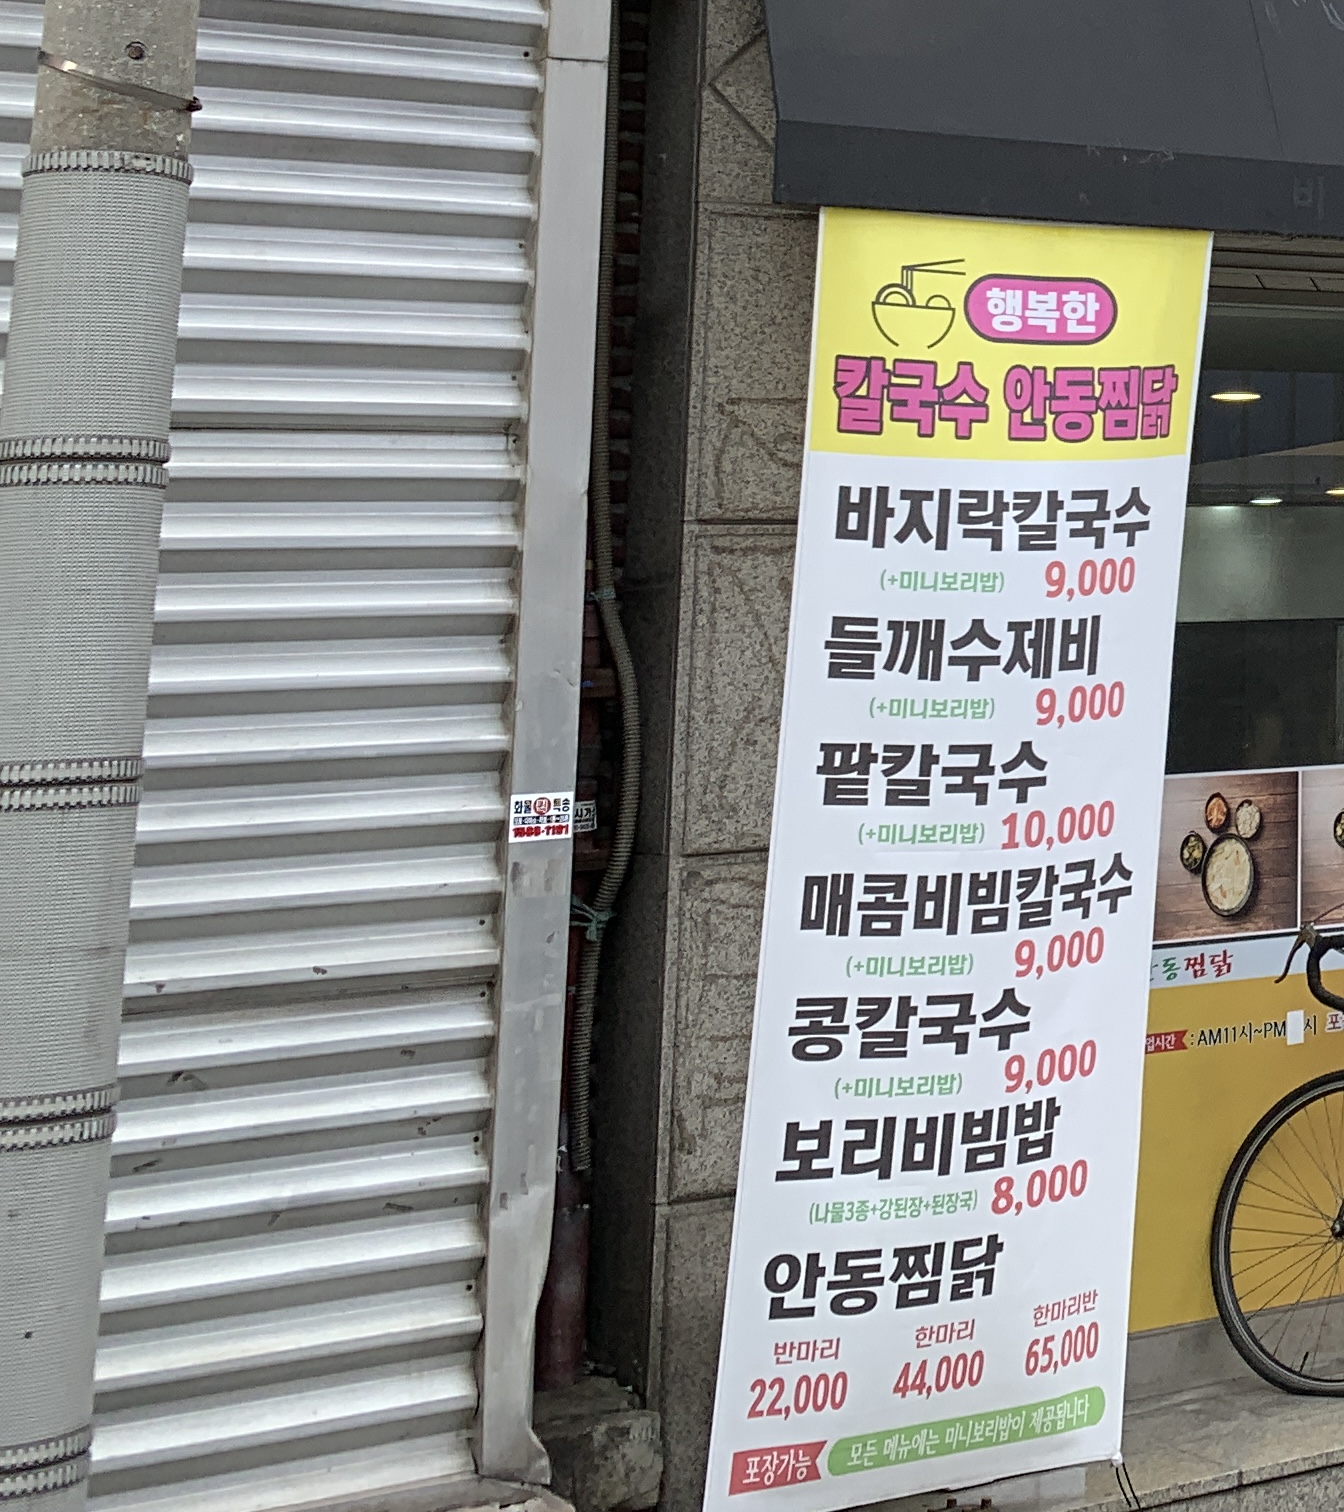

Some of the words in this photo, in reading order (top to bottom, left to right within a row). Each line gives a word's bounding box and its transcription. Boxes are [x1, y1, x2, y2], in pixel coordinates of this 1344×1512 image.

[986, 287, 1099, 335] 행복한
[834, 355, 989, 438] 칼국수
[1003, 365, 1178, 442] 안동찜닭
[834, 485, 1152, 552] 바지락칼국수
[879, 568, 1005, 594] (+미니보리밥)
[1044, 557, 1136, 601] 9,000
[824, 615, 1101, 682] 들깨수제비
[869, 696, 996, 722] (+미니보리밥)
[1035, 681, 1126, 728] 9,000
[816, 740, 1049, 807] 팥칼국수
[858, 822, 986, 847] (+미니보리밥)
[1001, 800, 1116, 851] 10,000
[800, 852, 1134, 938] 매콤비빔칼국수
[846, 952, 975, 979] (+미니보리밥)
[1014, 926, 1104, 979] 9,000
[1150, 949, 1233, 981] 동찜닭
[788, 987, 1032, 1062] 콩칼국수
[834, 1072, 963, 1100] (+미니보리밥)
[1004, 1040, 1097, 1094] 9,000
[774, 1097, 1062, 1182] 보리비빔밥
[809, 1189, 979, 1225] (나물3종+강된장+된장국)
[990, 1159, 1089, 1215] 8,000
[763, 1233, 1005, 1320] 안동찜닭
[773, 1337, 841, 1364] 반마리
[915, 1319, 975, 1349] 한마리
[1033, 1289, 1099, 1327] 한마리반
[747, 1370, 848, 1420] 22,000
[892, 1349, 985, 1399] 44,000
[1024, 1321, 1100, 1376] 65,000
[846, 1442, 877, 1467] 모든
[883, 1430, 941, 1461] 메뉴에는
[944, 1415, 1025, 1446] 미니보리밥이
[1029, 1393, 1091, 1433] 제공됩니다
[742, 1452, 812, 1485] 포장가능
